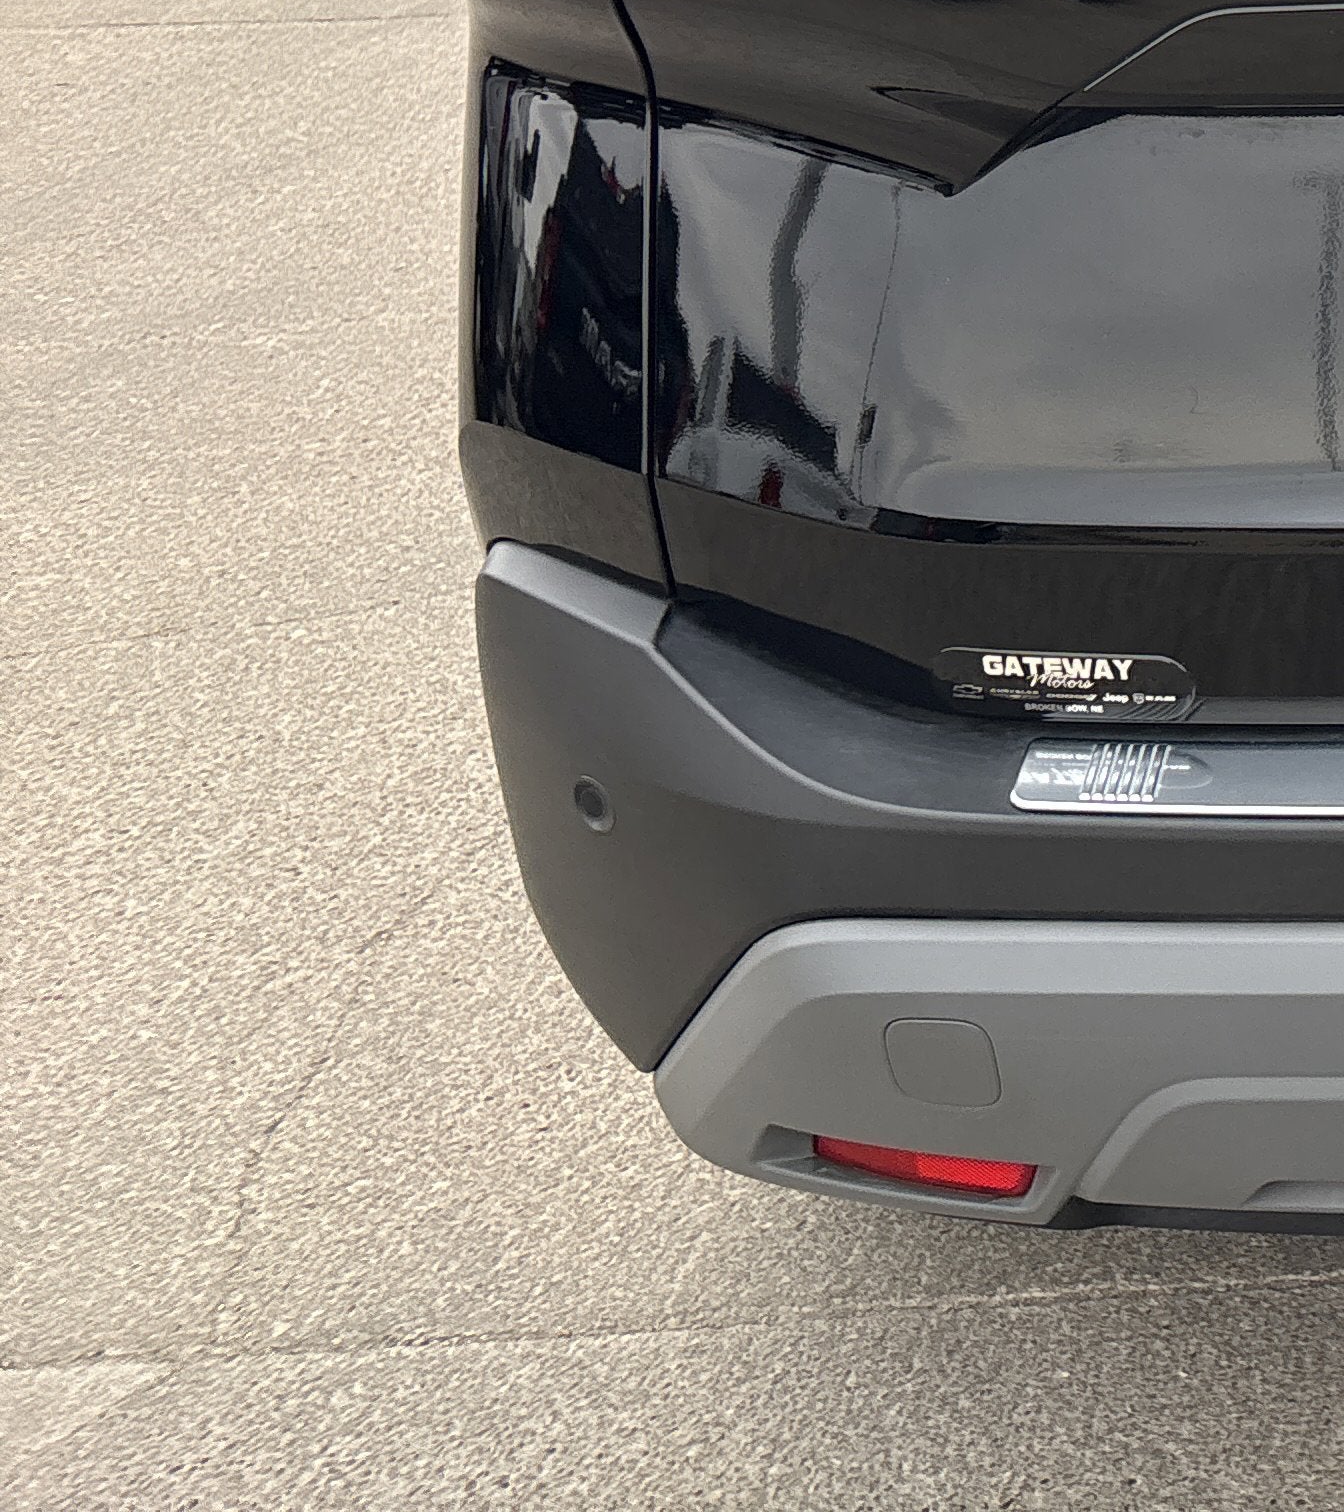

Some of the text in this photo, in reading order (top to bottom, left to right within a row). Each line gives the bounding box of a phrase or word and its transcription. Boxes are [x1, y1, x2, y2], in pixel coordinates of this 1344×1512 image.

[982, 654, 1134, 681] GATEWAY
[1026, 673, 1096, 690] Motors
[1102, 692, 1129, 704] Jeep
